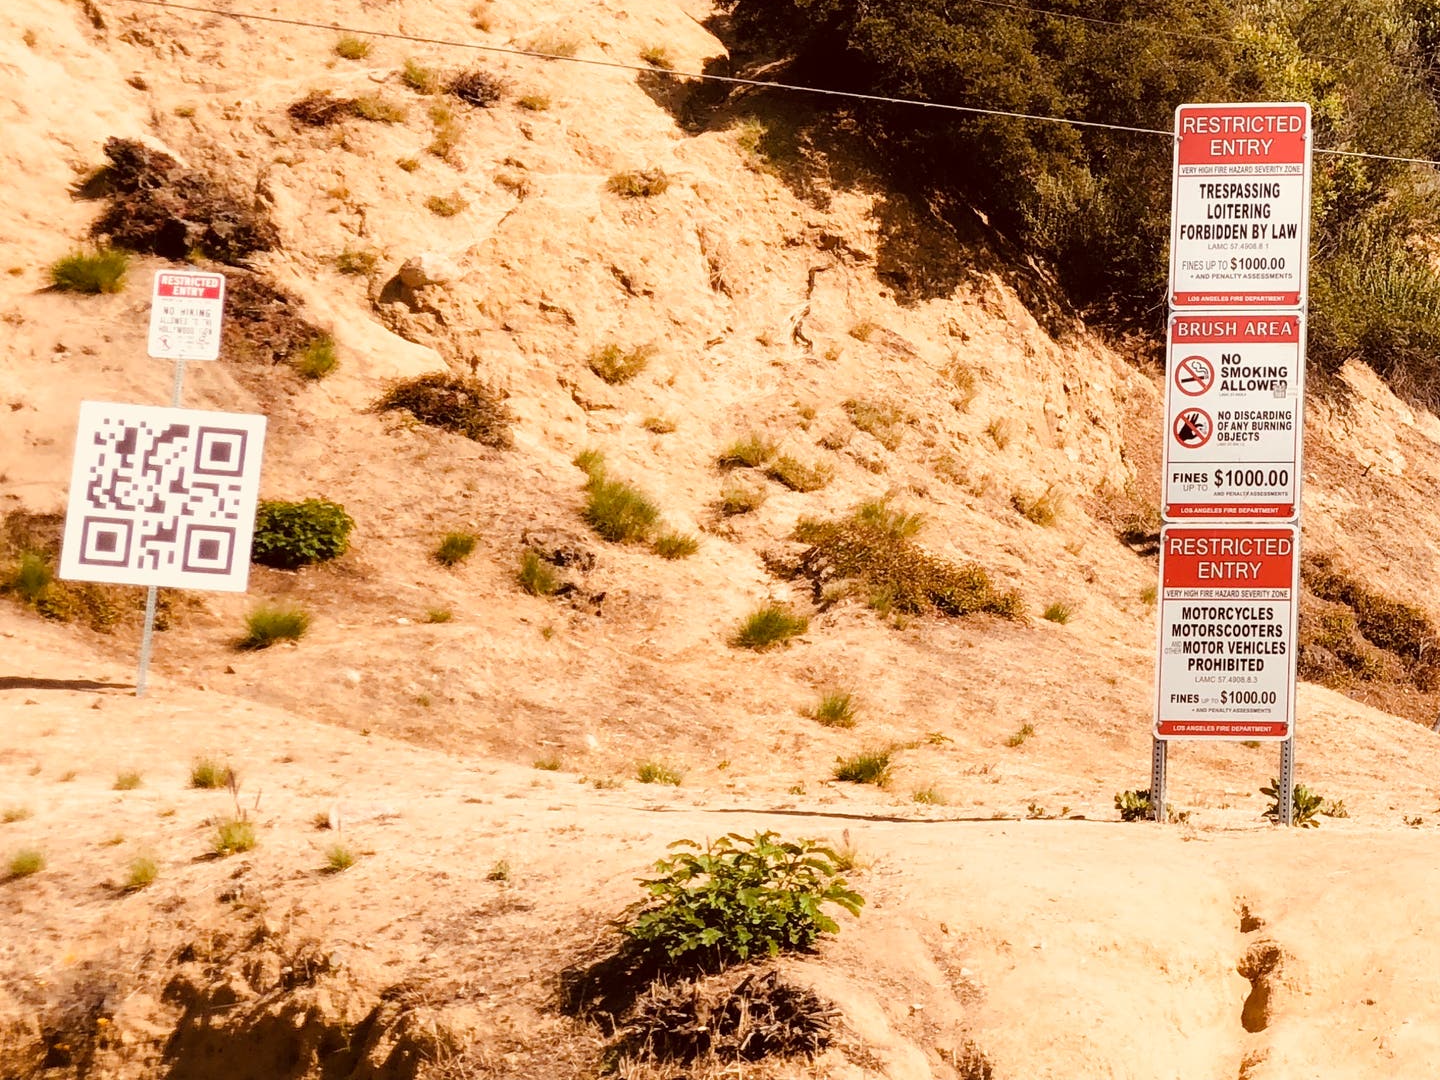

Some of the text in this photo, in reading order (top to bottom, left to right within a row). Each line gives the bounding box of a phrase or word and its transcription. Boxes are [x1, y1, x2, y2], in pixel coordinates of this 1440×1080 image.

[1183, 116, 1301, 133] RESTRICTED
[1210, 139, 1273, 156] ENTRY
[1200, 183, 1280, 199] TRESPASSING
[1207, 204, 1271, 219] LOITERING
[1180, 224, 1297, 240] FORBIDDEN BY LAW
[1182, 258, 1285, 271] FINES UP TO $1000.00
[161, 275, 218, 288] RESTRICTED
[173, 286, 205, 296] ENTRY
[1178, 322, 1292, 336] BRUSH AREA
[1221, 354, 1241, 365] NO
[1221, 366, 1287, 378] SMOKING
[1220, 380, 1287, 391] ALLOWED
[1218, 411, 1292, 420] NO DISCARDING
[1218, 422, 1292, 430] OF ANY BURNING
[1217, 432, 1260, 441] OBJECTS
[1173, 470, 1288, 487] FINES $1000.00
[1170, 538, 1291, 556] RESTRICTED
[1198, 562, 1262, 579] ENTRY
[1182, 608, 1273, 620] MOTORCYCLES
[1172, 624, 1282, 637] MOTORSCOOTERS
[1183, 641, 1223, 654] MOTOR
[1228, 641, 1286, 654] VEHICLES
[1188, 659, 1264, 671] PROHIBITED
[1170, 694, 1199, 704] FINES
[1220, 691, 1276, 704] $1000.00
